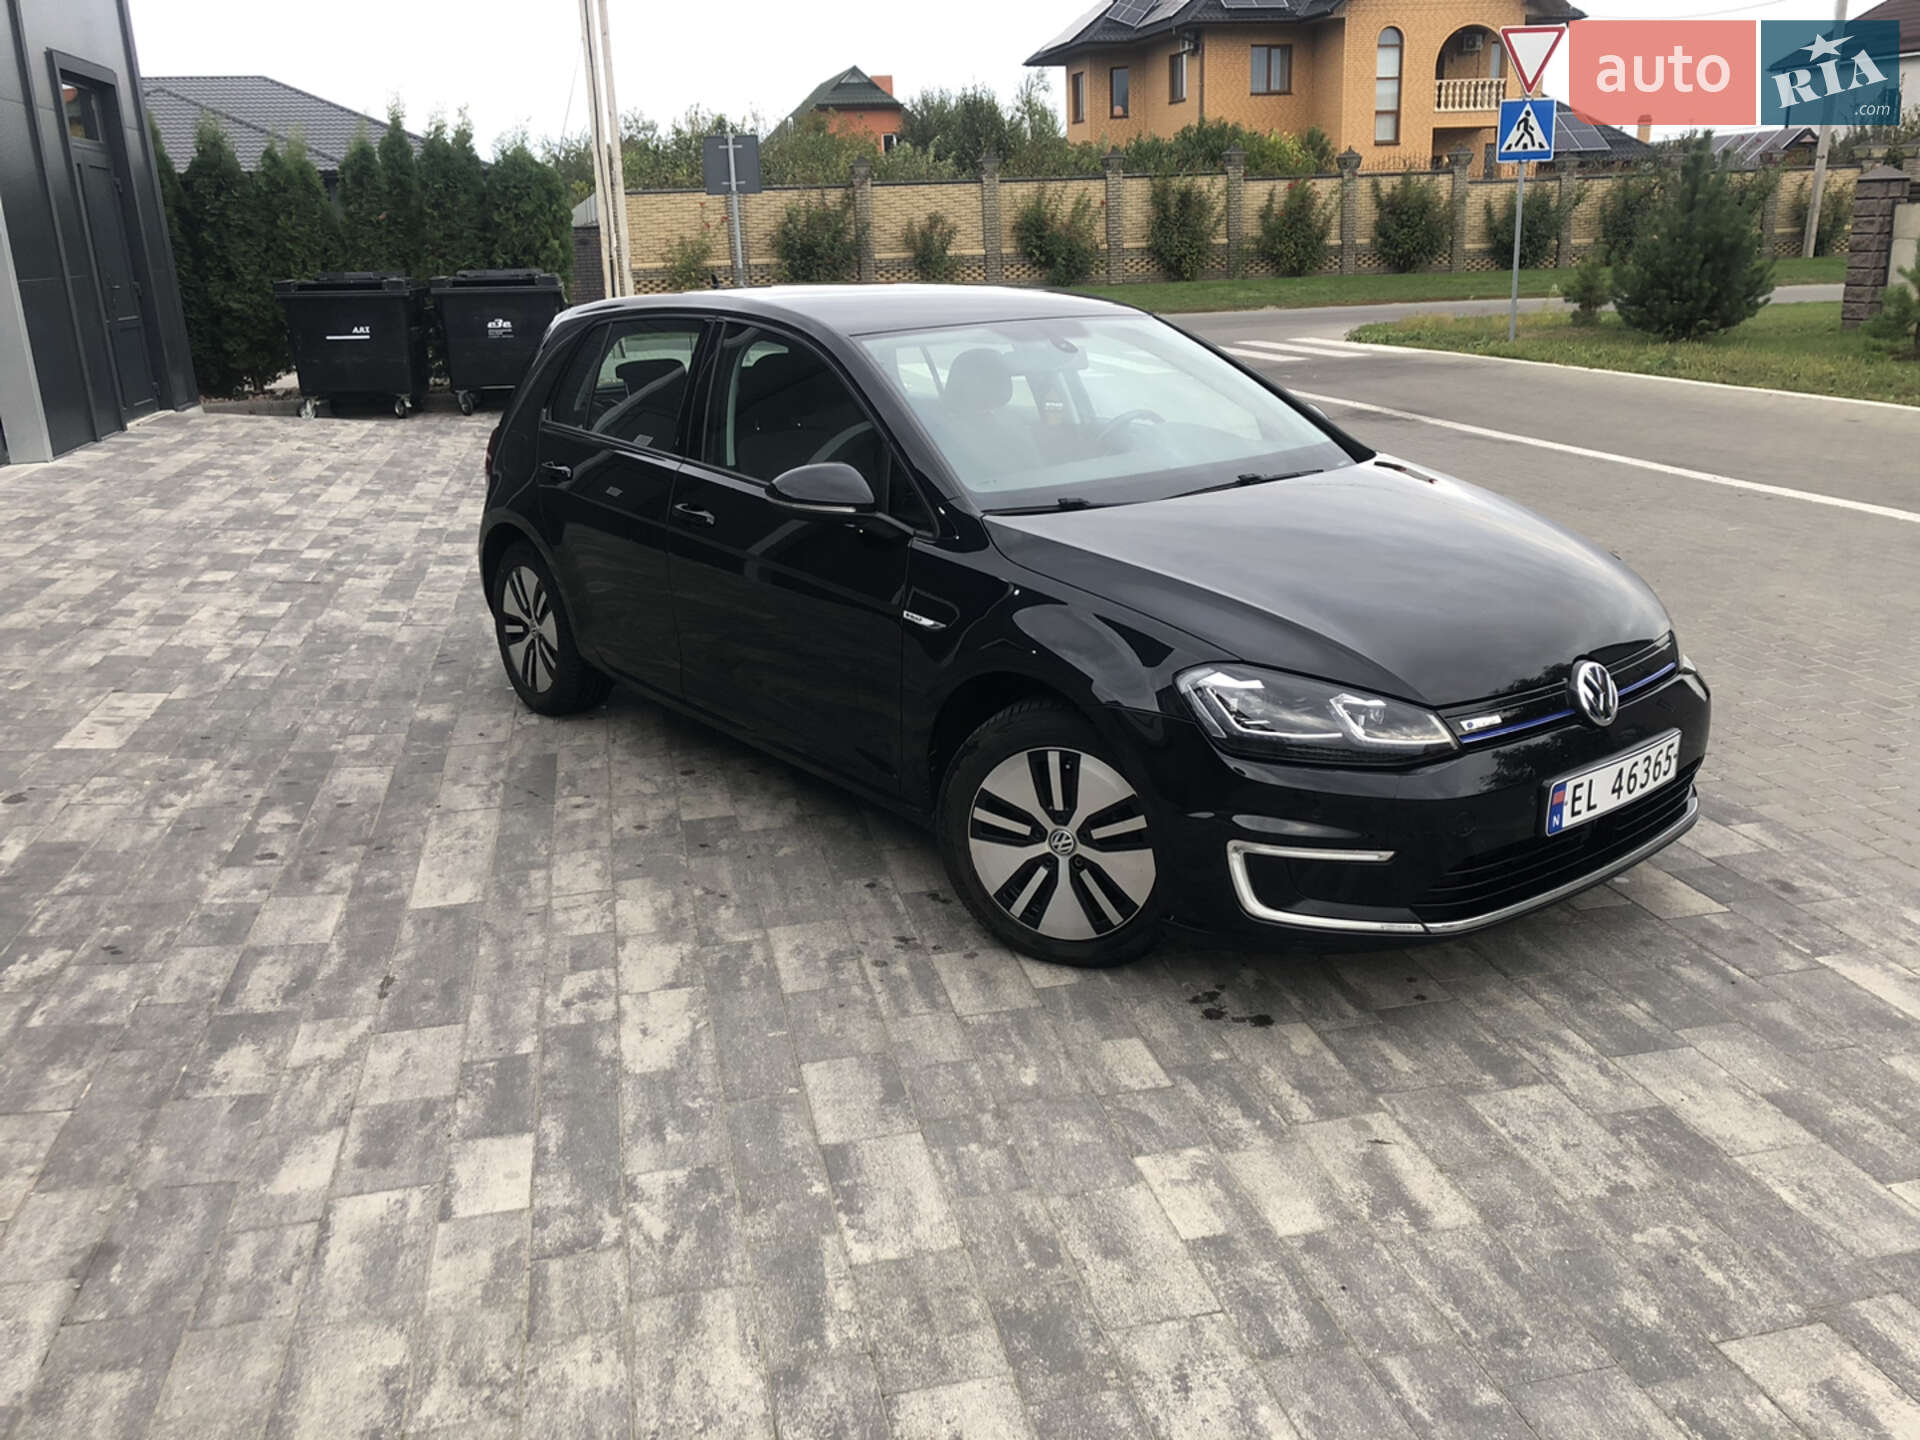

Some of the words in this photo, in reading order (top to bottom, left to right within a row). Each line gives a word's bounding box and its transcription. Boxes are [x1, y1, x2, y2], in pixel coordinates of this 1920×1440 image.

[1570, 778, 1598, 818] EL
[1610, 742, 1676, 801] 46365
[1551, 813, 1561, 829] N
